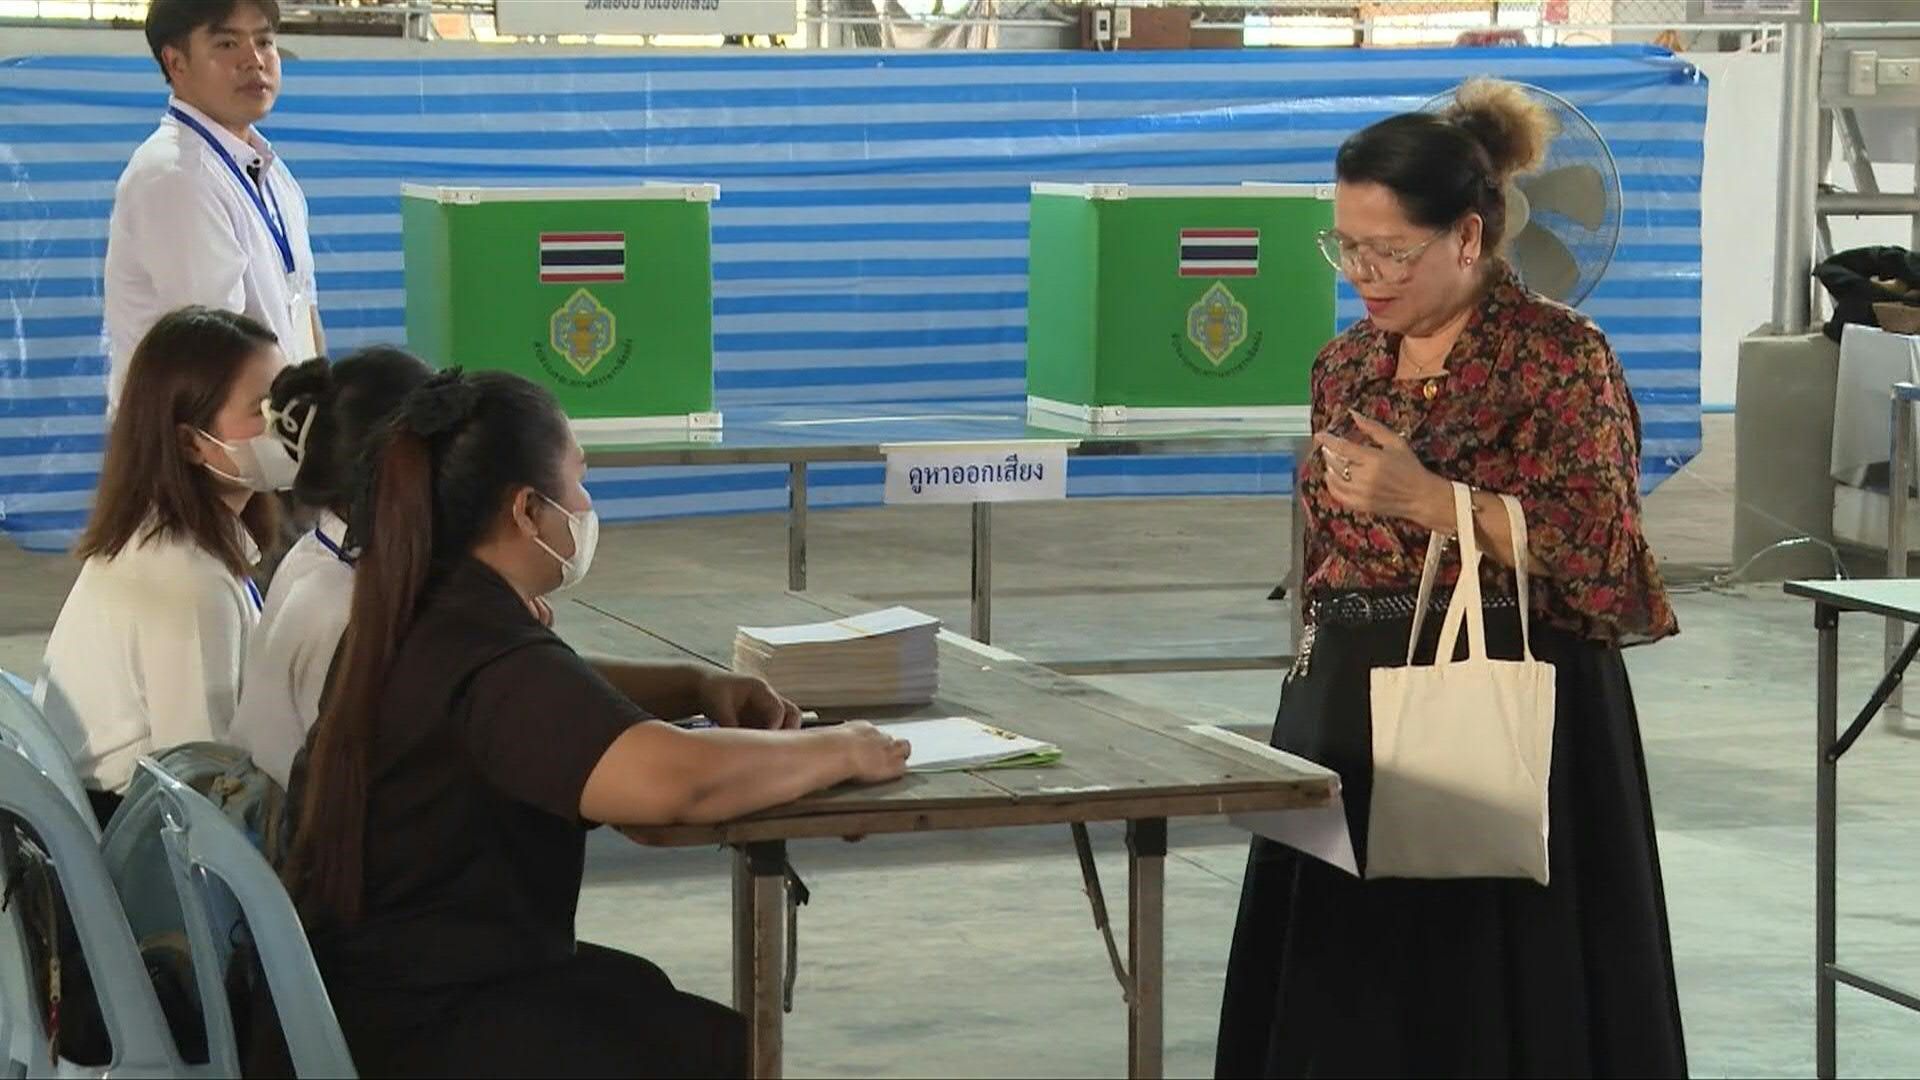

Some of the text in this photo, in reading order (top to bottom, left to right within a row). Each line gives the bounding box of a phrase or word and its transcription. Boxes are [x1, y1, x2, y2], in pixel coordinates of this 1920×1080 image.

[909, 453, 1044, 494] คูหาออกเสียง
